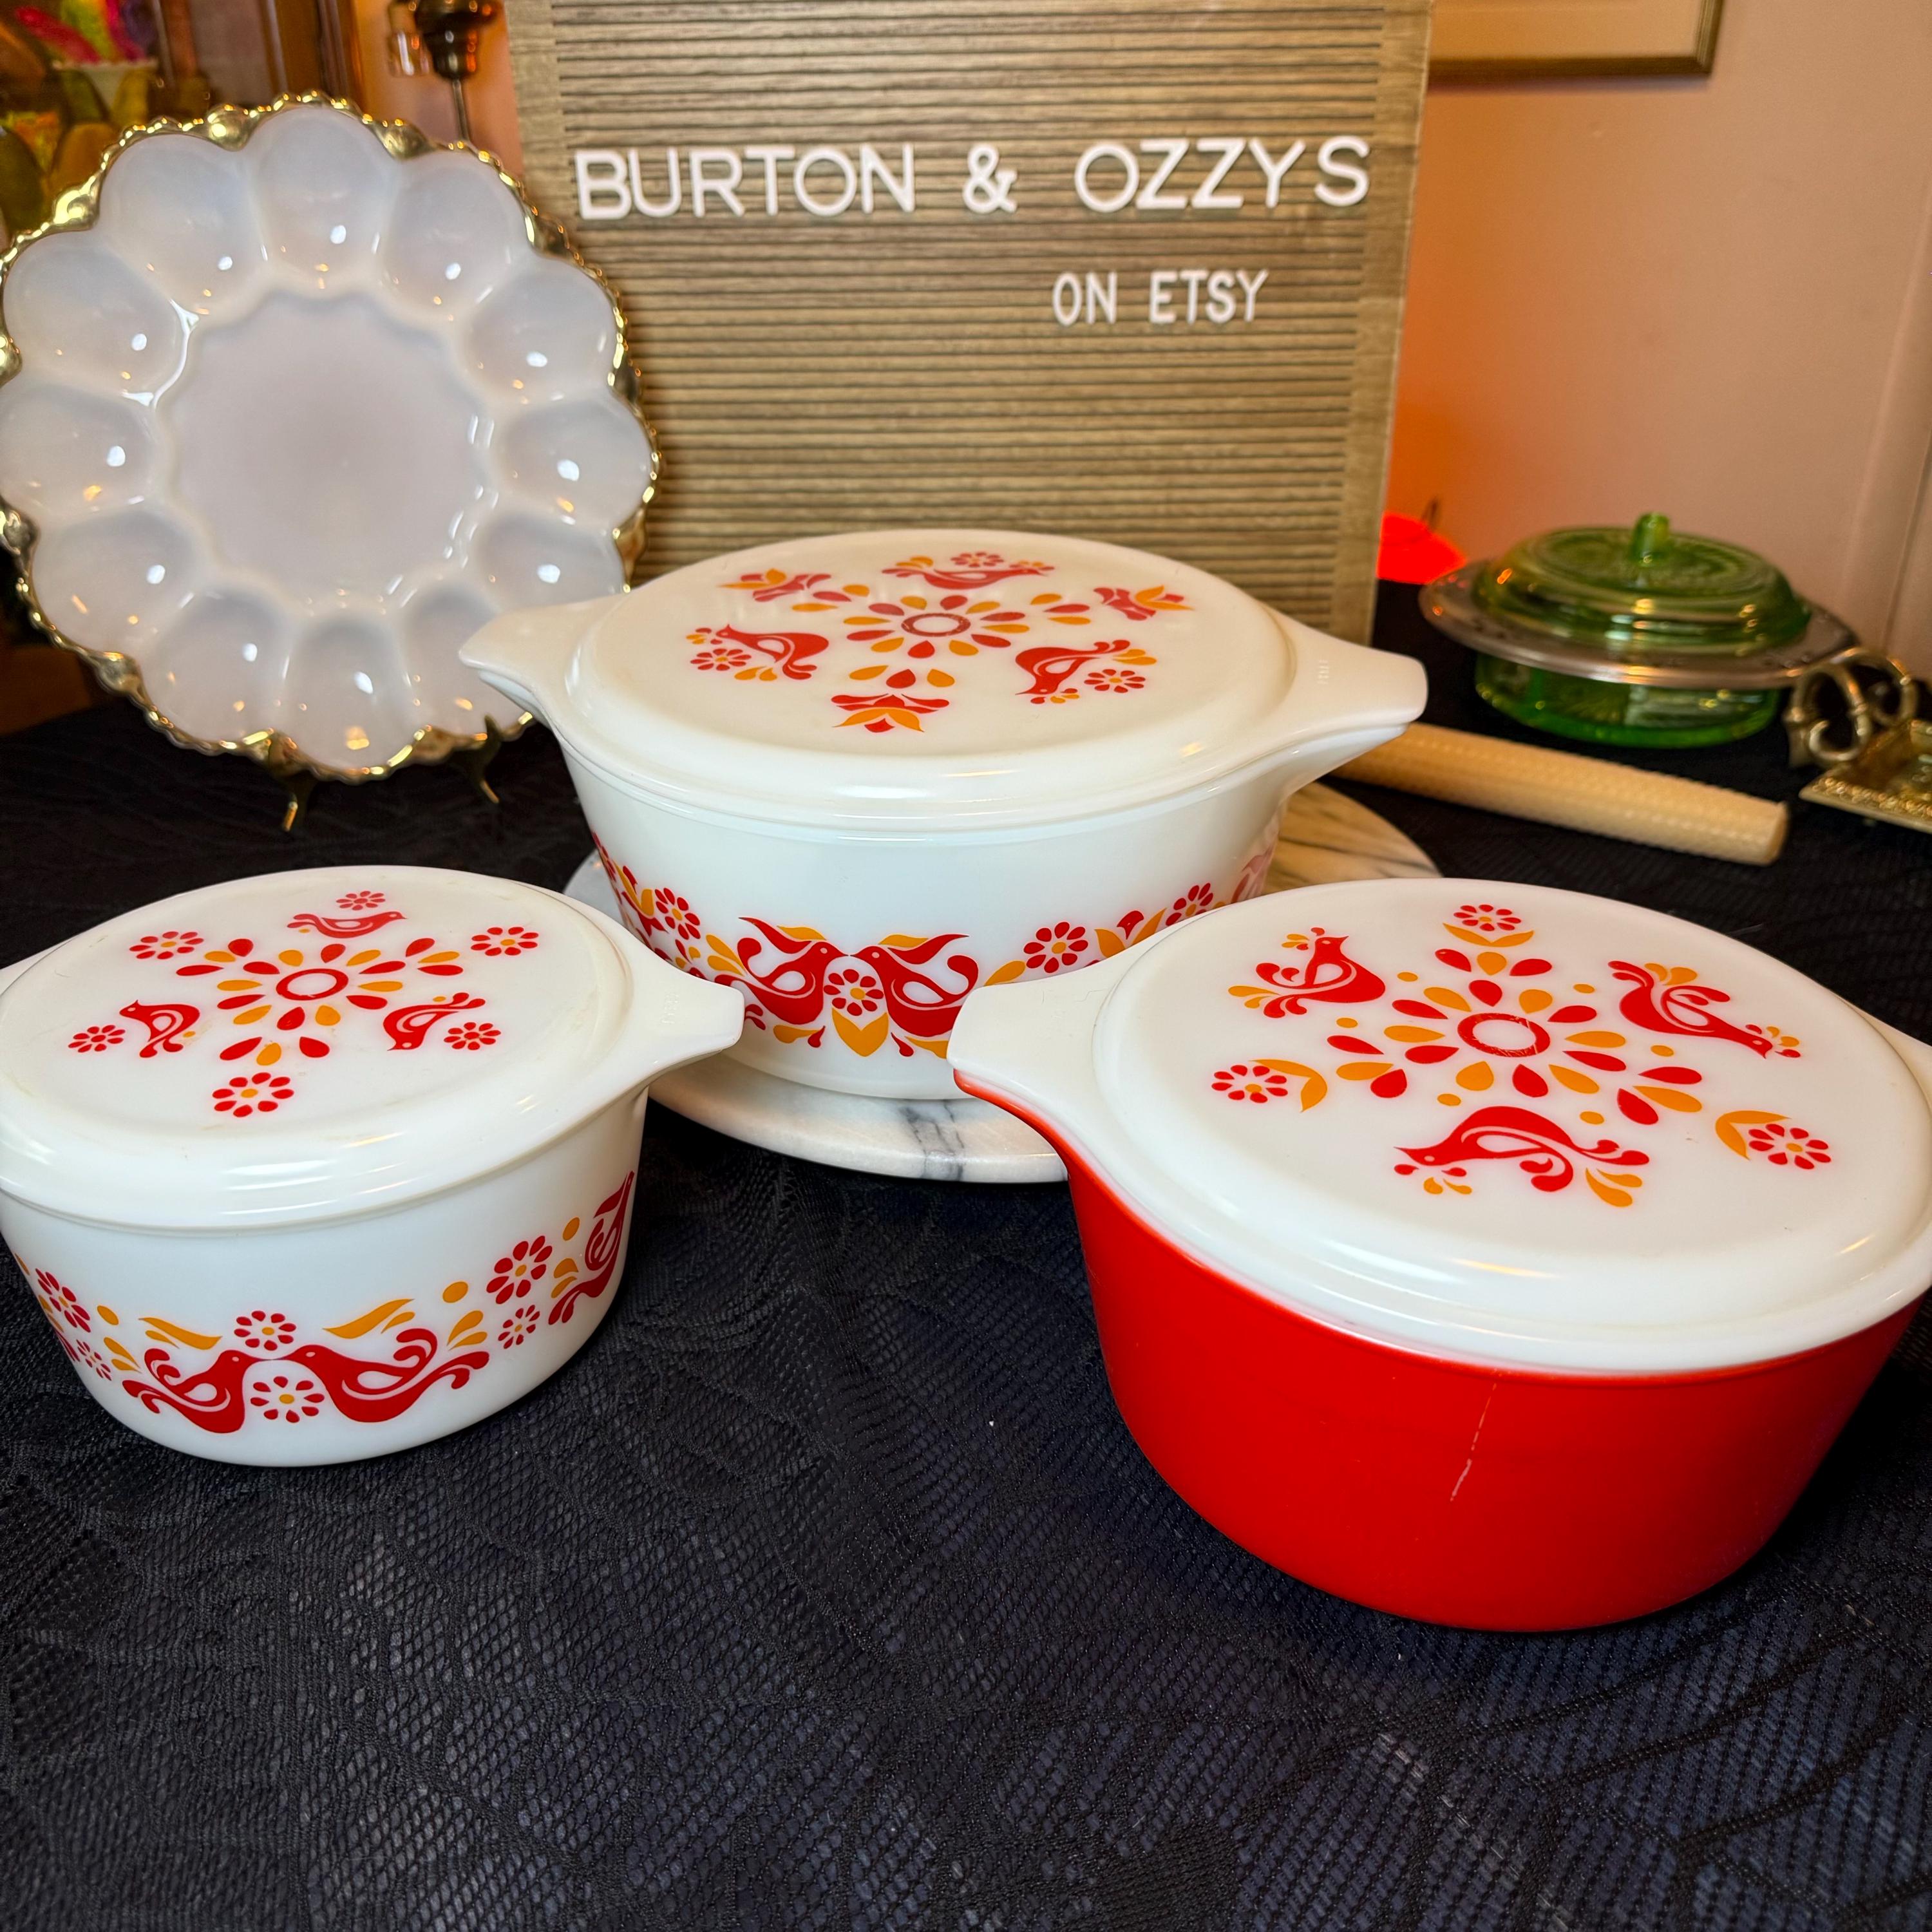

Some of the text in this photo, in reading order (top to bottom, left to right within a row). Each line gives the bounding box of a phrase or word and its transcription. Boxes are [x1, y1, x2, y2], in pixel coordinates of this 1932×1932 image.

[576, 136, 1370, 220] BURTON & OZZYS
[1052, 269, 1269, 326] ON ETSY
